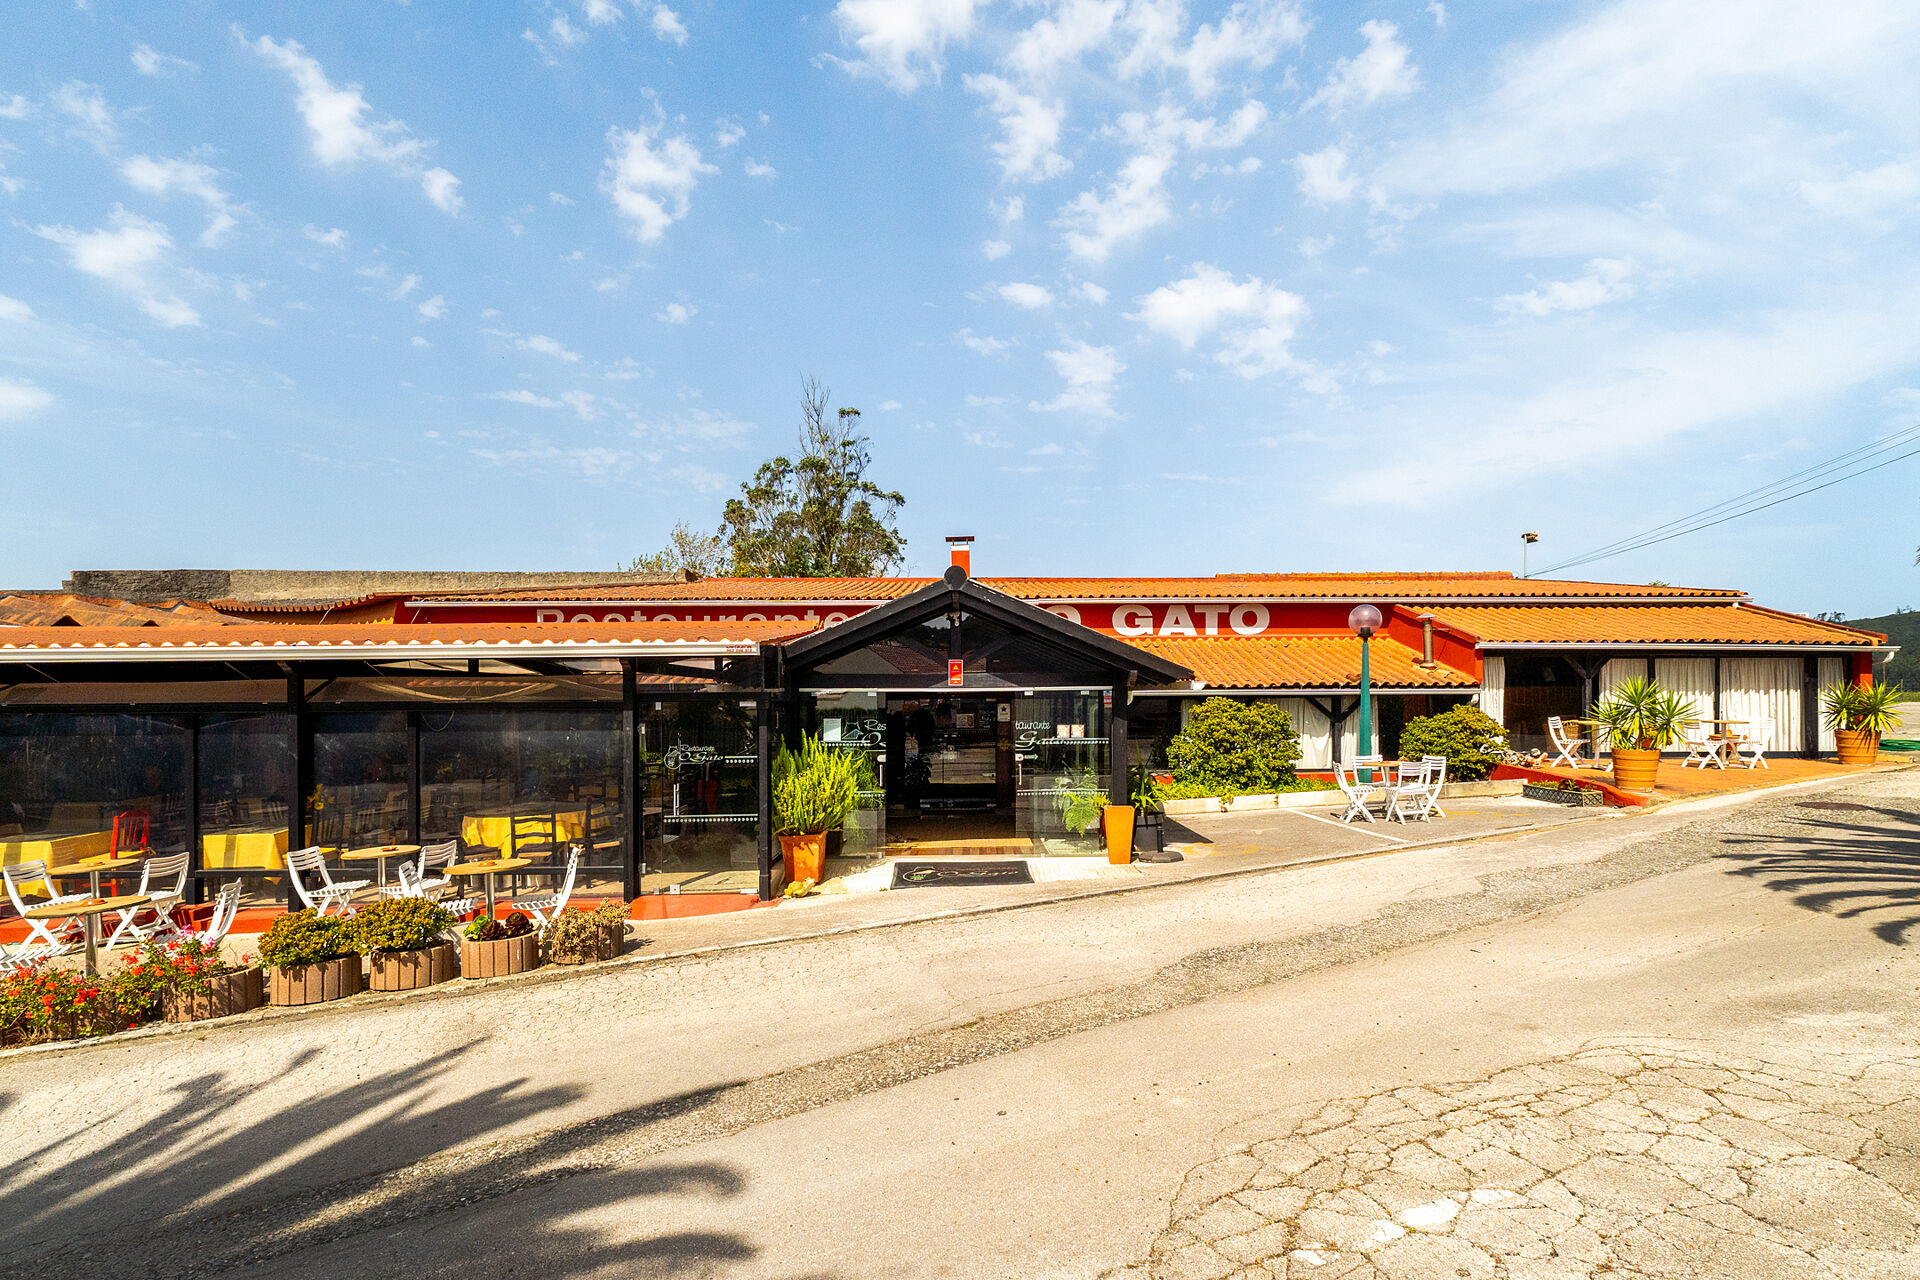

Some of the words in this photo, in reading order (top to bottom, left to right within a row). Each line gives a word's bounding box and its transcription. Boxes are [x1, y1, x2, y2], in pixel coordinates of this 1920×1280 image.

[1111, 603, 1270, 637] GATO
[863, 718, 887, 731] Res
[1015, 720, 1051, 730] taurante
